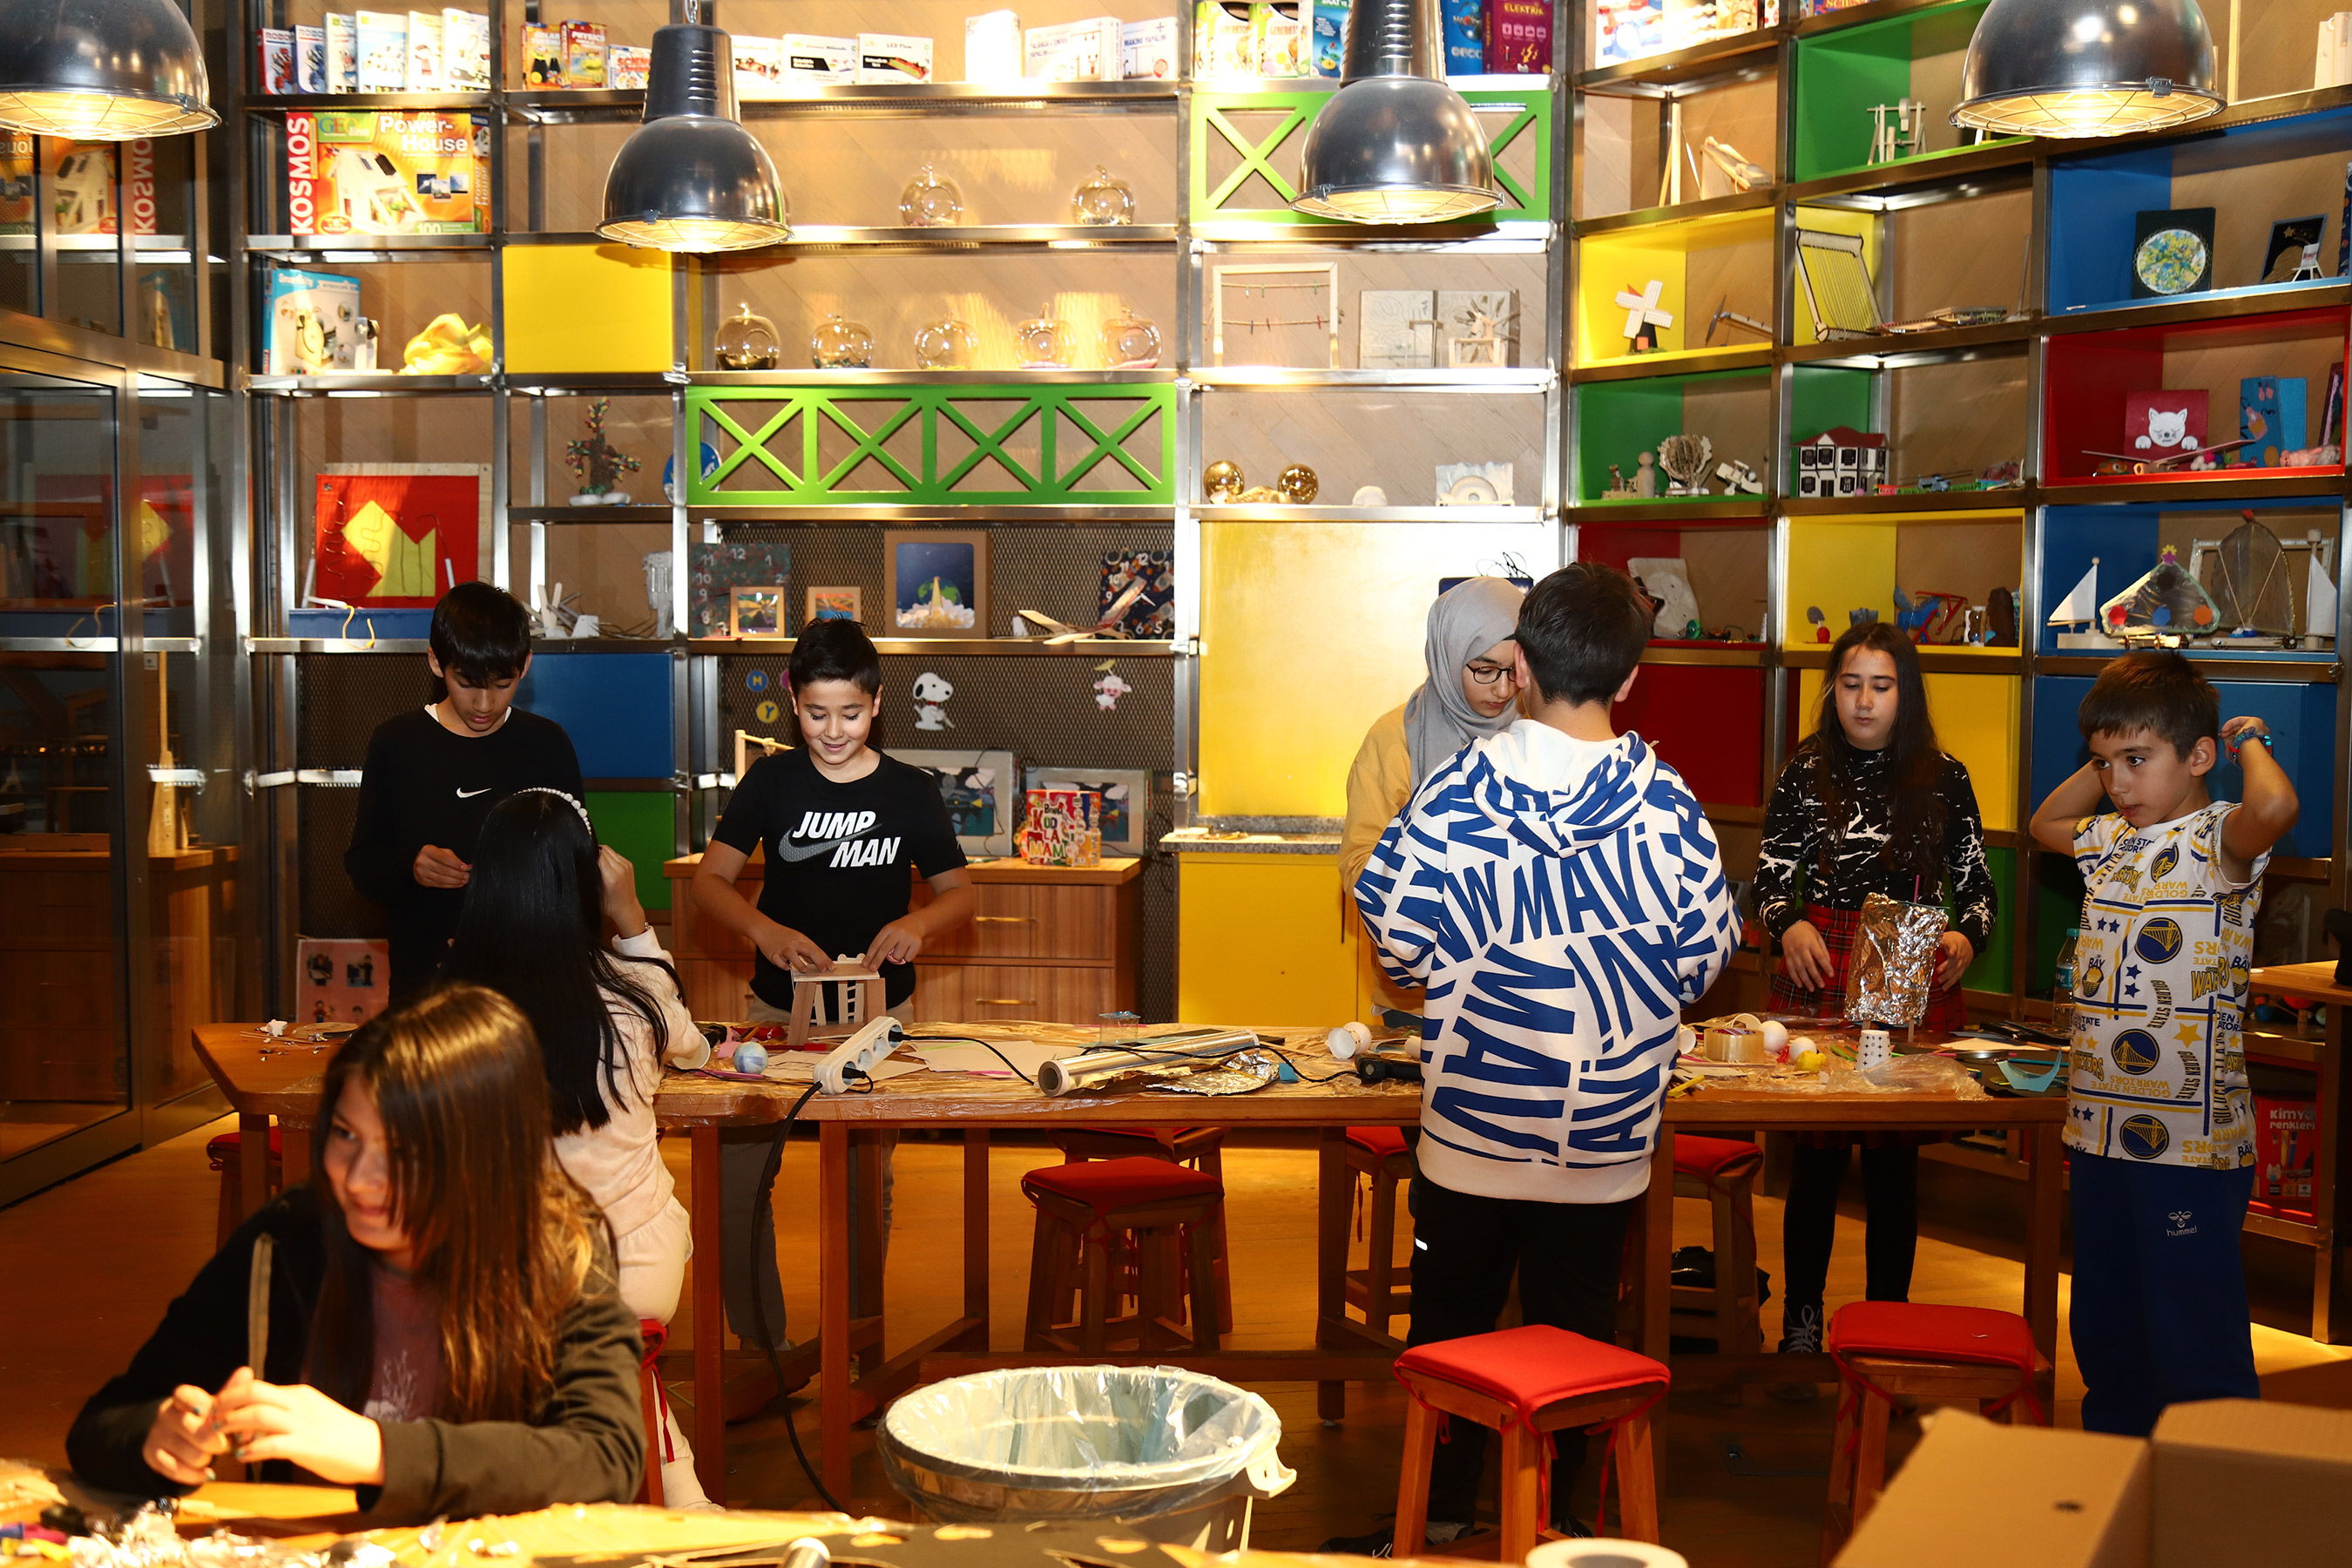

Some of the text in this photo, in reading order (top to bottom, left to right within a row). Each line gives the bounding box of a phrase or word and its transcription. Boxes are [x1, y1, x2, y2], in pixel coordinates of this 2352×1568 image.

[380, 115, 454, 134] Power-
[402, 133, 469, 152] House
[287, 116, 315, 234] KOSMOS
[416, 222, 442, 233] 100
[700, 554, 714, 567] 11
[732, 548, 746, 560] 12
[1136, 552, 1148, 565] 12
[1119, 560, 1130, 572] 11
[695, 572, 712, 585] 10
[775, 573, 784, 584] 2
[700, 588, 707, 603] 9
[1105, 591, 1113, 603] 9
[701, 611, 711, 625] 8
[1135, 622, 1144, 634] 6
[1153, 620, 1162, 634] 5
[753, 675, 762, 686] M
[765, 704, 774, 720] Y
[792, 810, 876, 839] JUMP
[829, 836, 902, 868] MAN
[2089, 958, 2106, 970] BAY
[2146, 979, 2173, 1029] GOLDEN STATE
[2175, 1051, 2201, 1098] GOLDEN STATE
[2110, 1074, 2171, 1090] WARRIORS
[2091, 1081, 2172, 1098] GOLDEN STATE
[2166, 1225, 2198, 1237] hummel
